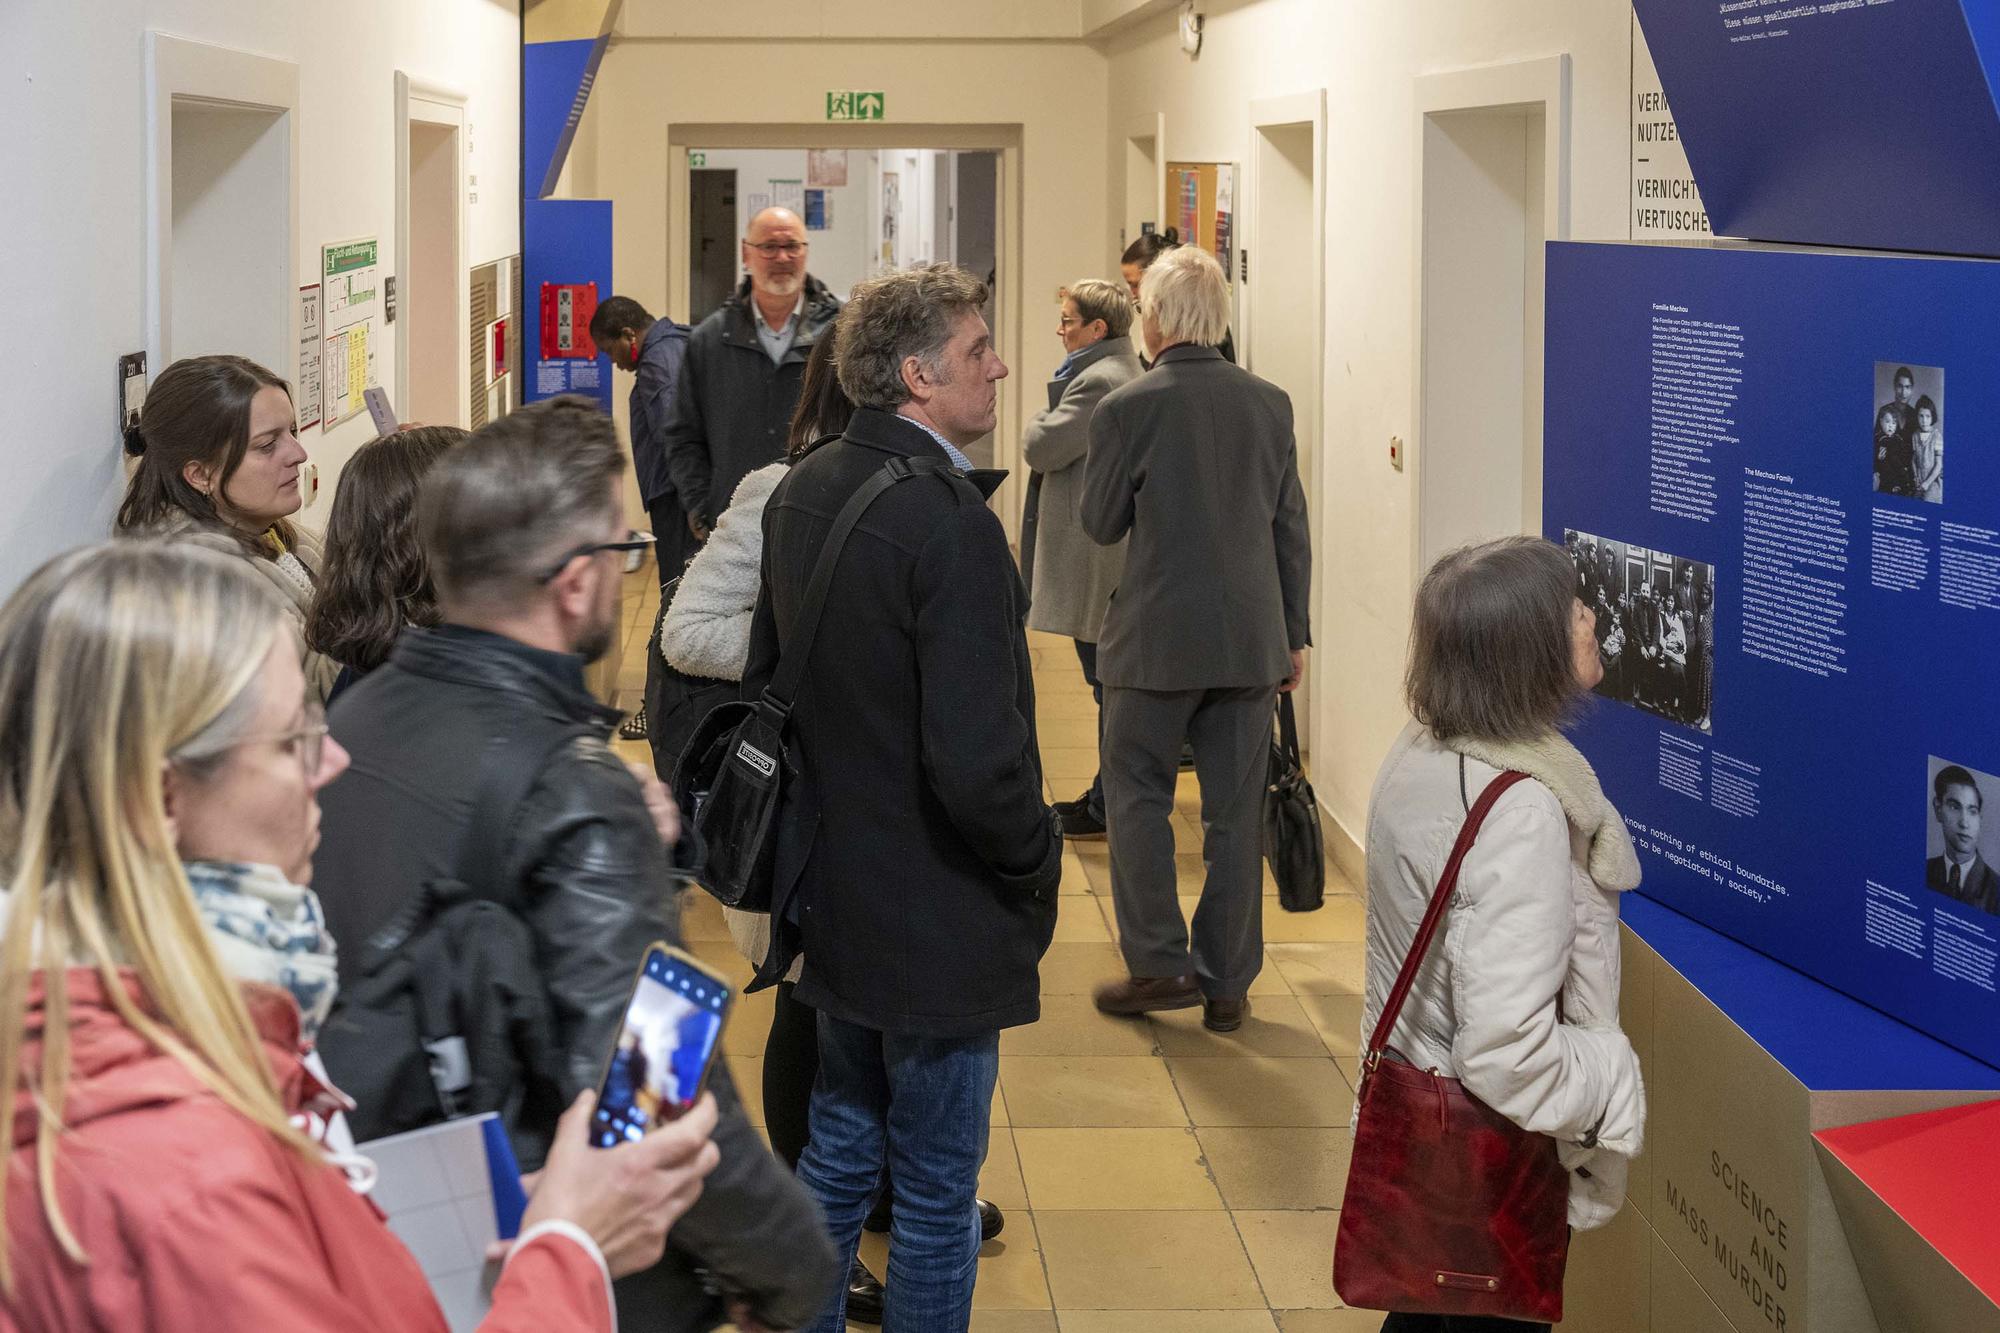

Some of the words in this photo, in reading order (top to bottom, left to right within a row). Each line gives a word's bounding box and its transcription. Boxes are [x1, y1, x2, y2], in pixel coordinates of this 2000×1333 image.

[1744, 467, 1753, 475] The
[1776, 473, 1793, 484] Family
[1624, 816, 1646, 832] knows
[1650, 828, 1682, 850] nothing
[1686, 844, 1696, 853] of
[1700, 850, 1732, 871] ethical
[1736, 865, 1790, 896] boundaries.
[1640, 838, 1649, 849] to
[1652, 843, 1661, 854] be
[1665, 850, 1710, 877] negotiated
[1713, 871, 1724, 885] by
[1712, 1150, 1787, 1251] SCIENCE
[1666, 1179, 1708, 1245] MASS
[1715, 1234, 1786, 1333] MURDER
[1751, 1235, 1787, 1291] AND
